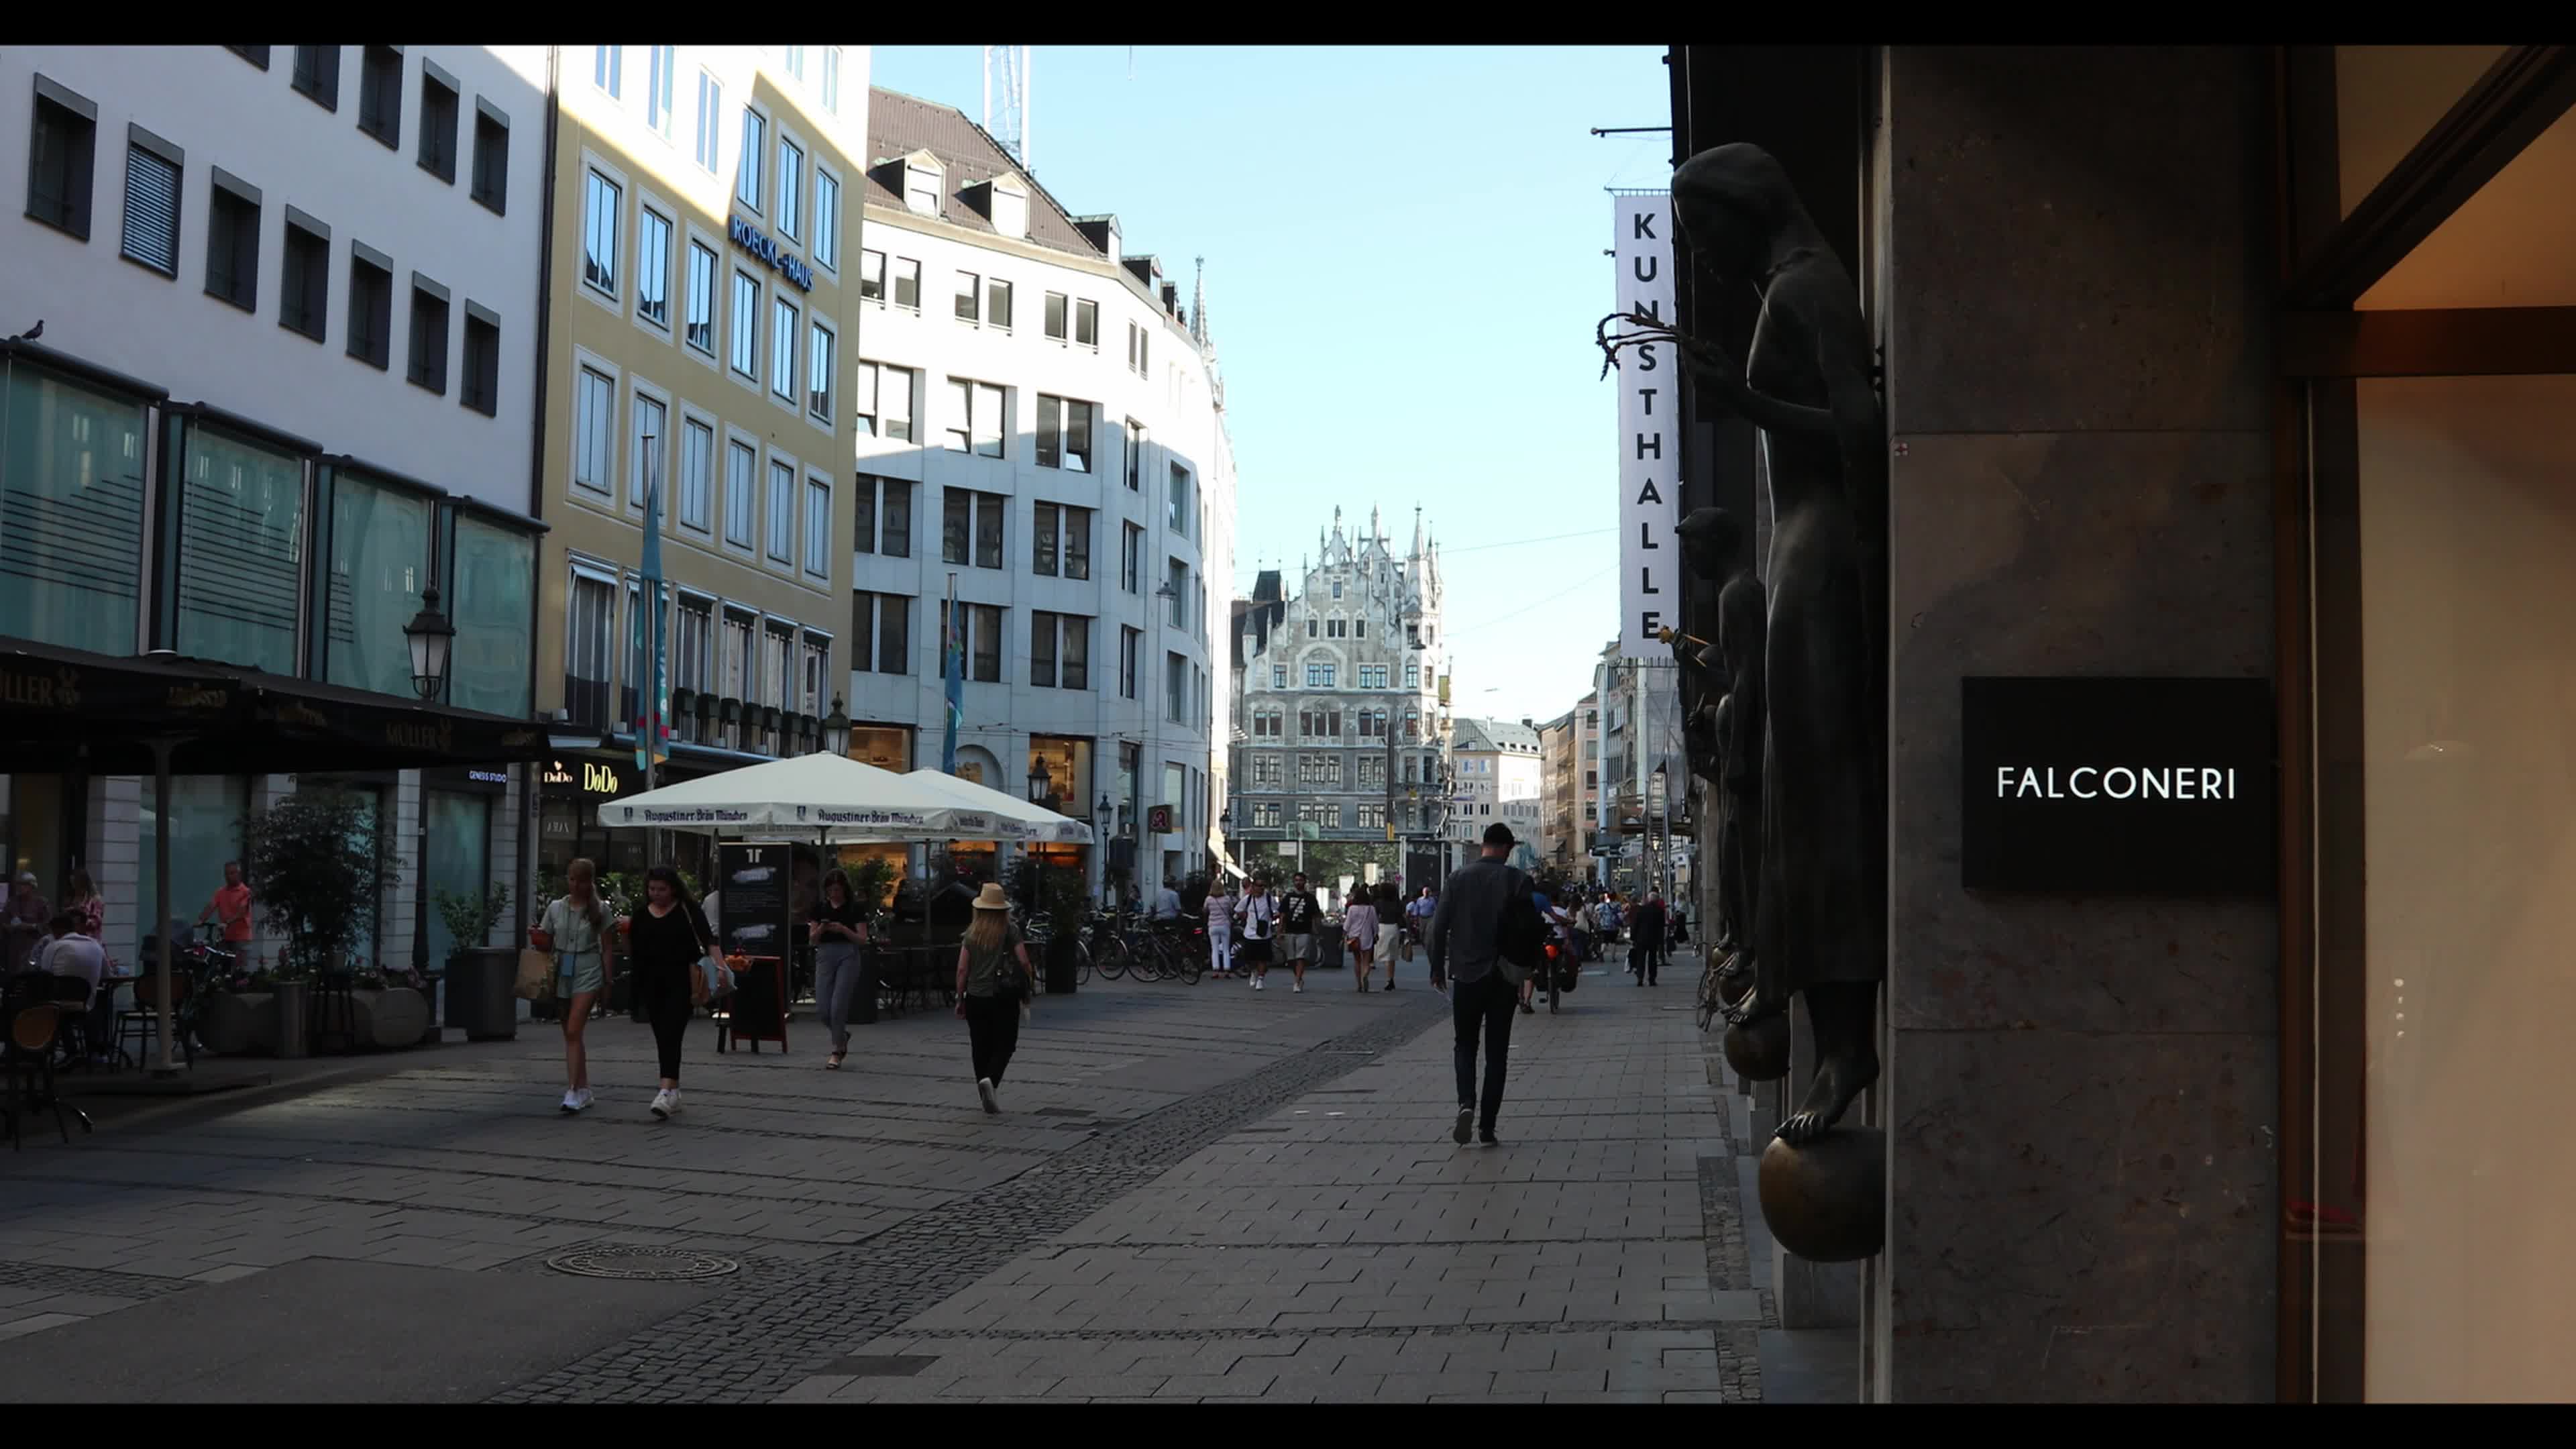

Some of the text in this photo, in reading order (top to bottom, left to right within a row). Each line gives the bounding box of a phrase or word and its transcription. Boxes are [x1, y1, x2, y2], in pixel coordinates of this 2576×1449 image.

[732, 215, 814, 290] ROECKL-HAUS
[1633, 213, 1662, 639] KUNSTHALLE
[584, 762, 619, 794] DoDo
[1997, 766, 2235, 799] FALCONERI
